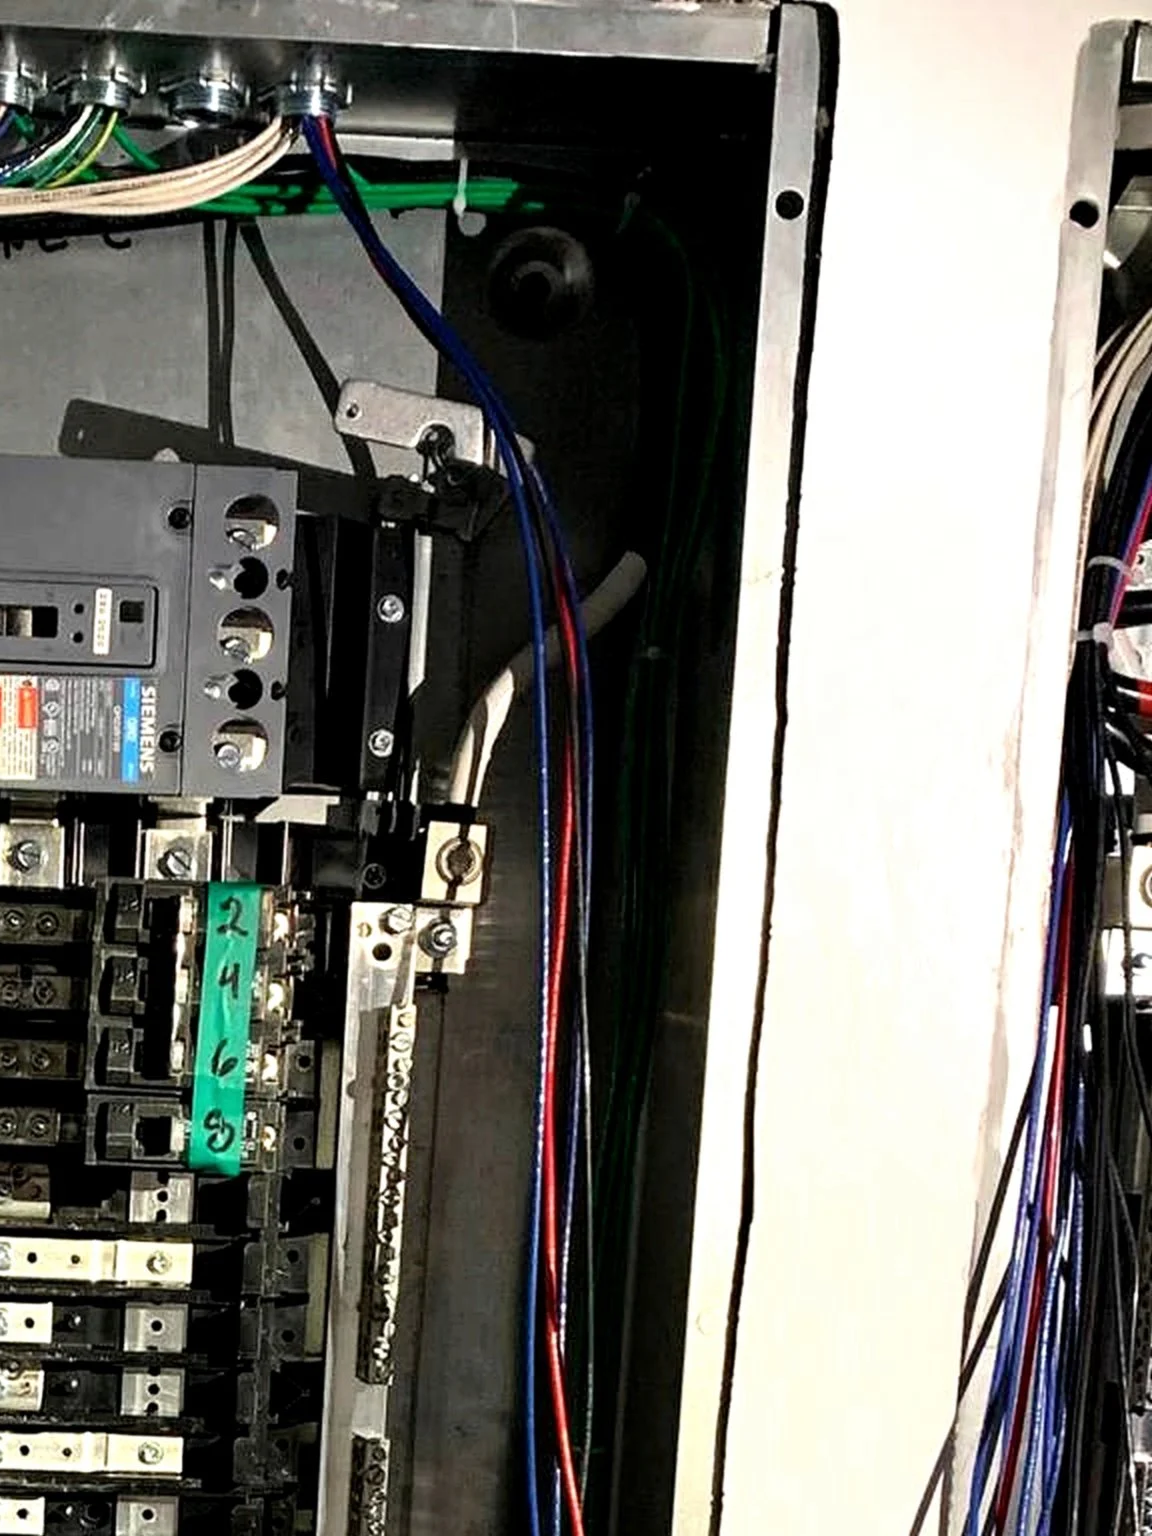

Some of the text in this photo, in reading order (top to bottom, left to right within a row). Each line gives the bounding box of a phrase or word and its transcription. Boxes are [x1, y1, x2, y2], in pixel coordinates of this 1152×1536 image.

[140, 685, 157, 773] SIEMENS
[218, 897, 247, 936] 2
[219, 964, 239, 998] 4
[212, 1040, 238, 1076] 6
[204, 1109, 235, 1152] 8
